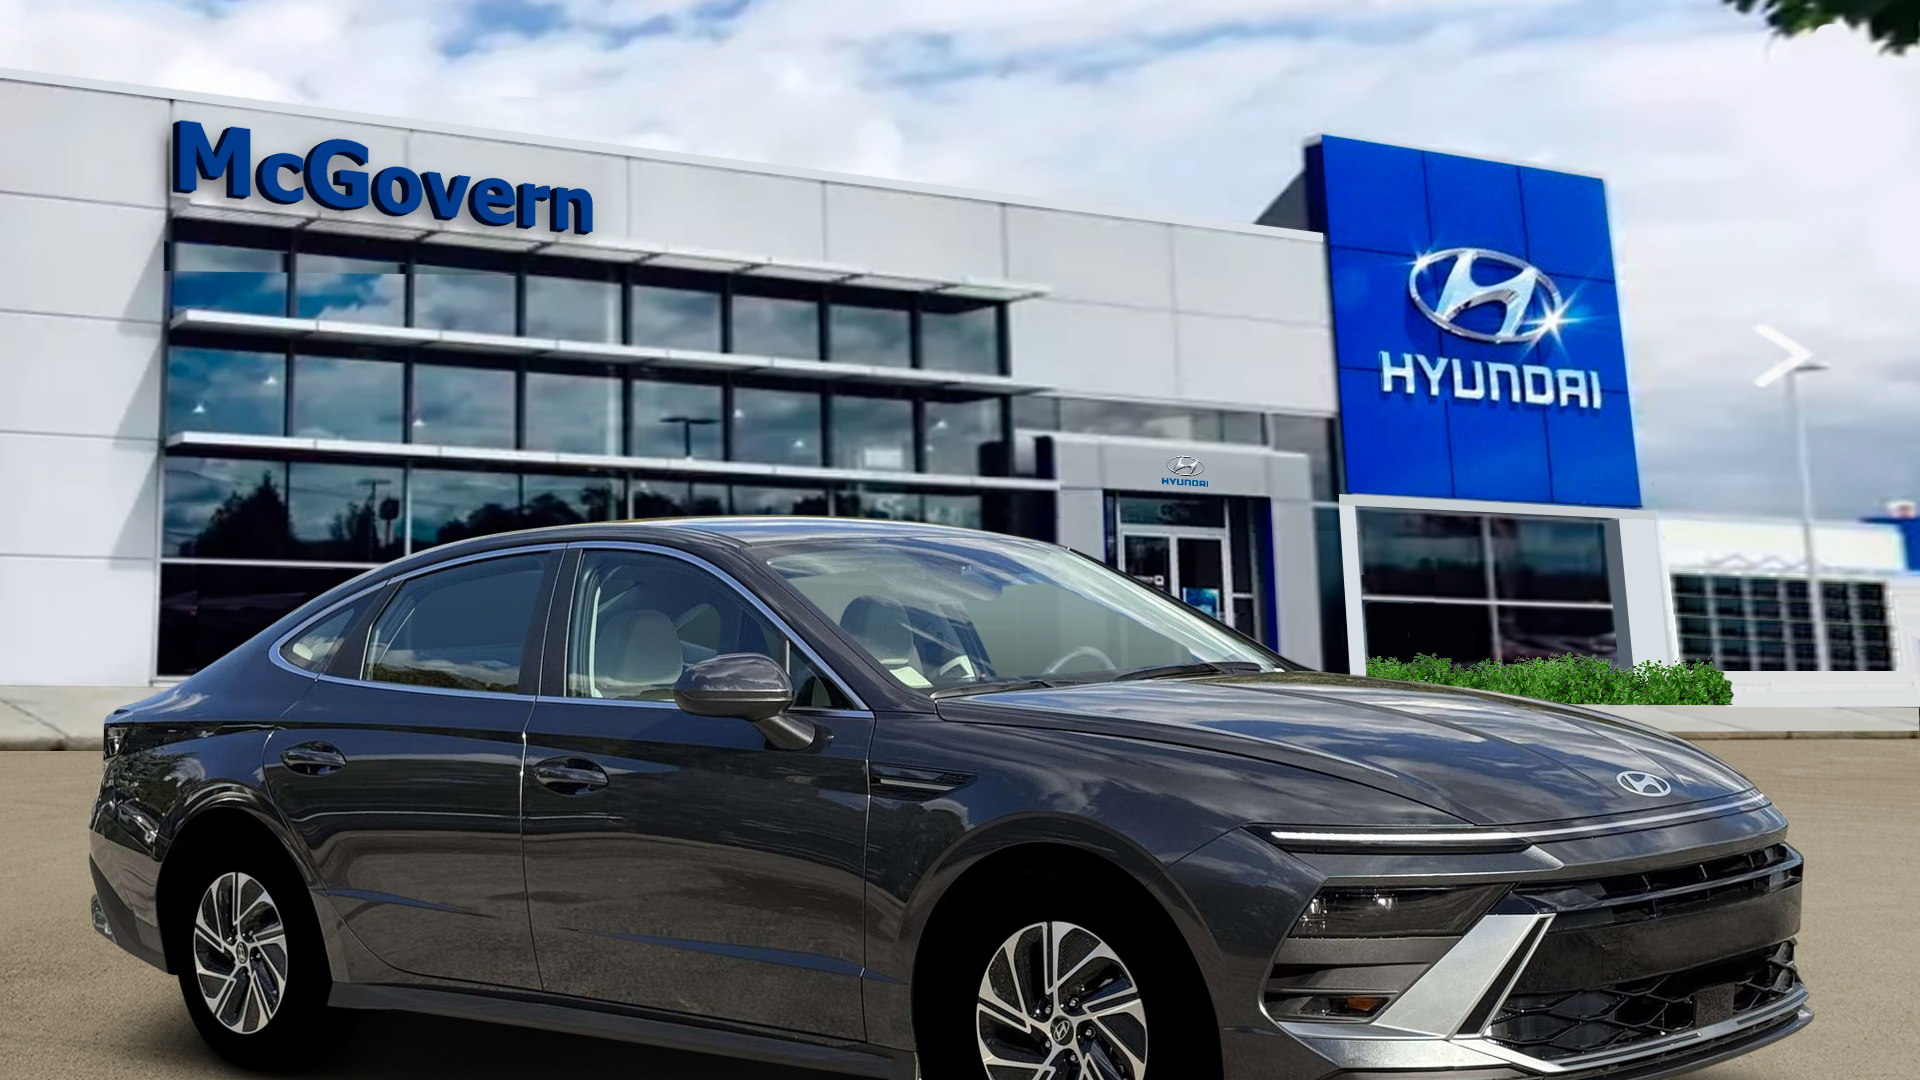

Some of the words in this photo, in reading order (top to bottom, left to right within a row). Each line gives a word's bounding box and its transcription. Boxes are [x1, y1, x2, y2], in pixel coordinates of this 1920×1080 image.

[172, 120, 594, 235] McGovern
[1379, 350, 1602, 409] HYUNDAI
[1161, 477, 1209, 488] HYUNDAI
